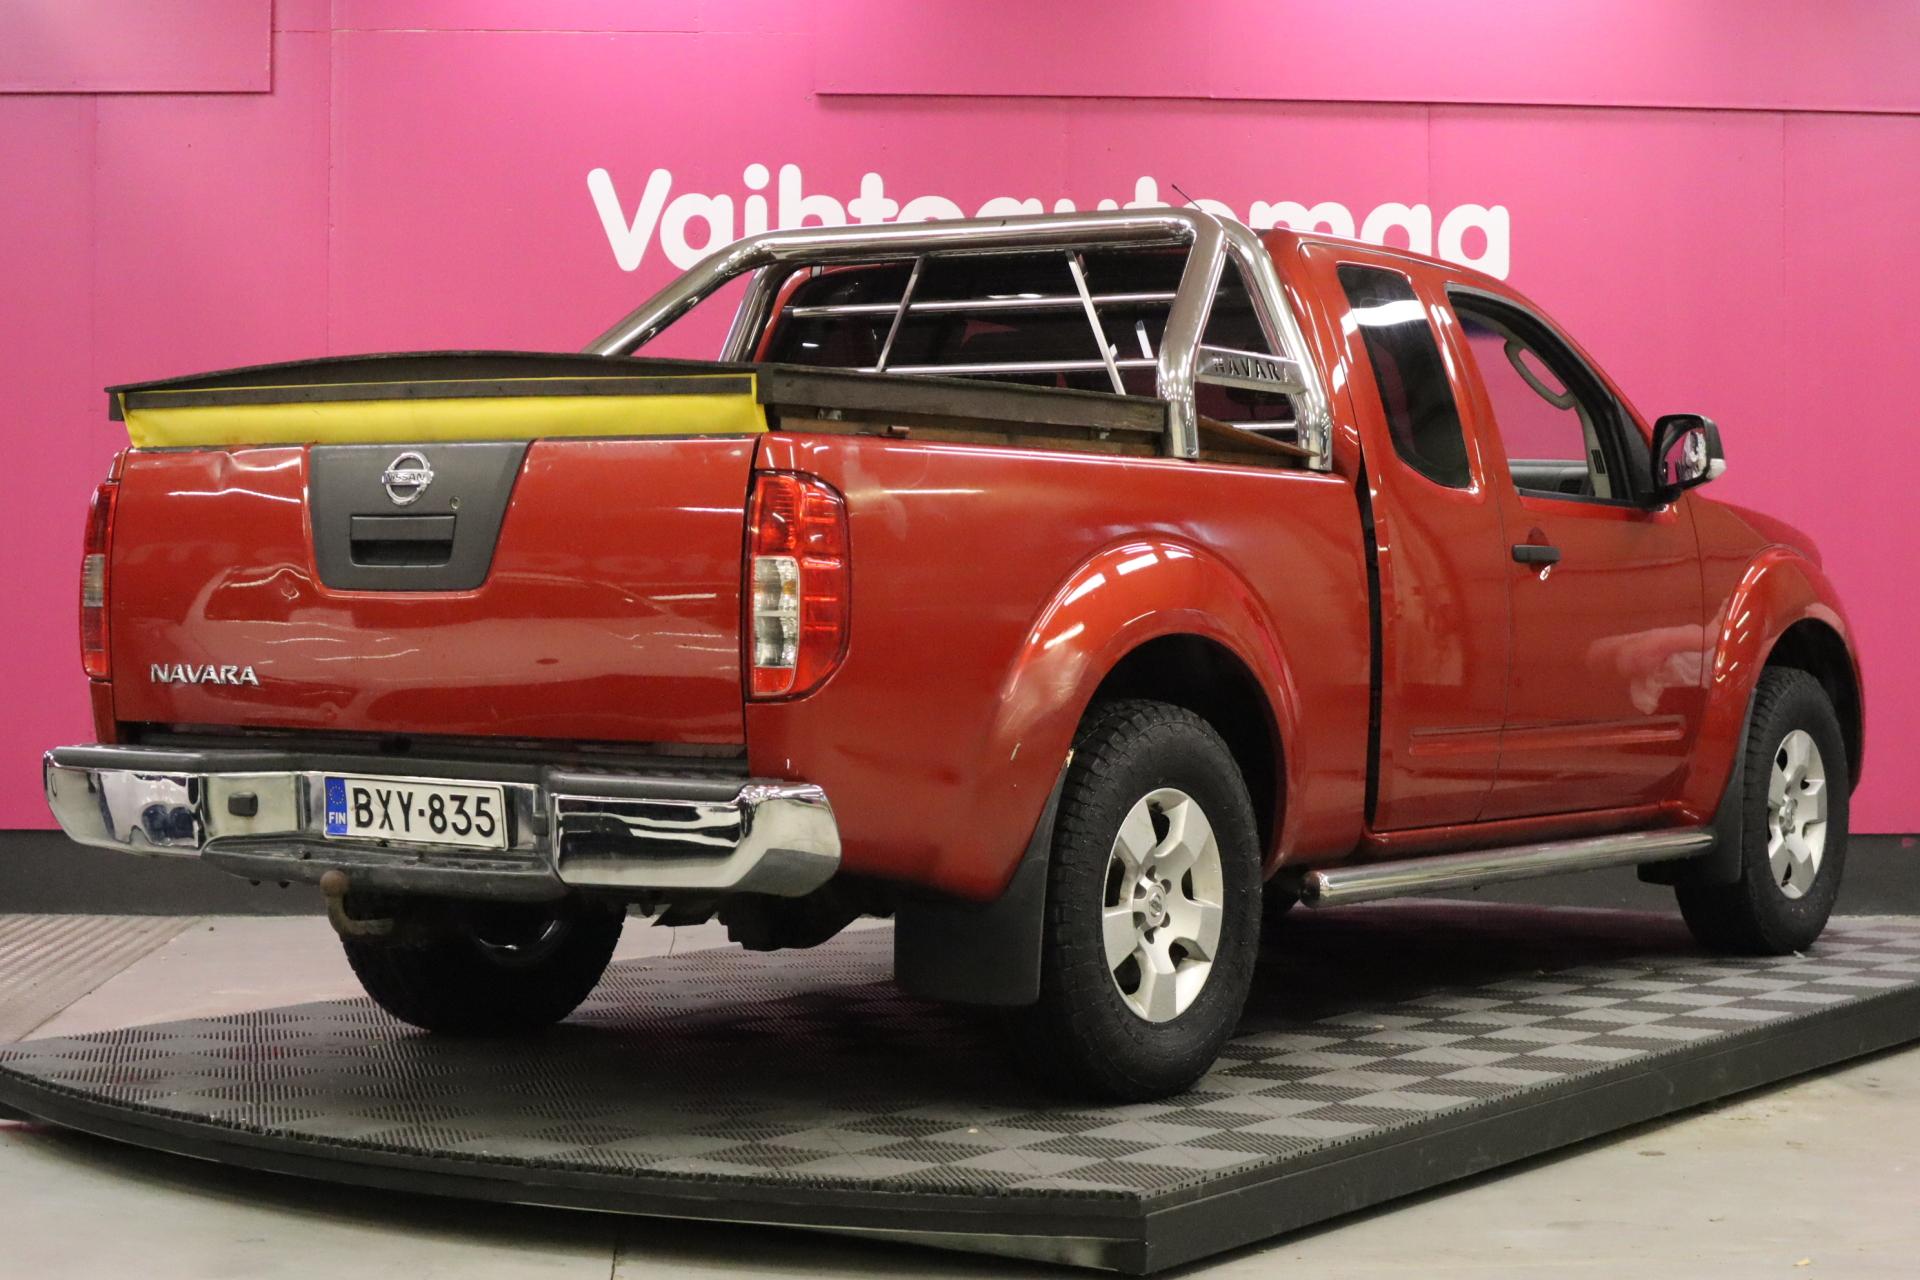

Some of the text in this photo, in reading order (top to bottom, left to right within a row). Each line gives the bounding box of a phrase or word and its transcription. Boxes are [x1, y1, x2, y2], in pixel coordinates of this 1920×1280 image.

[586, 163, 1510, 281] Vaihtaa
[1211, 352, 1291, 382] NAVAR
[150, 663, 259, 685] NAVARA
[328, 811, 346, 825] FIN
[352, 787, 496, 838] BXY-835
